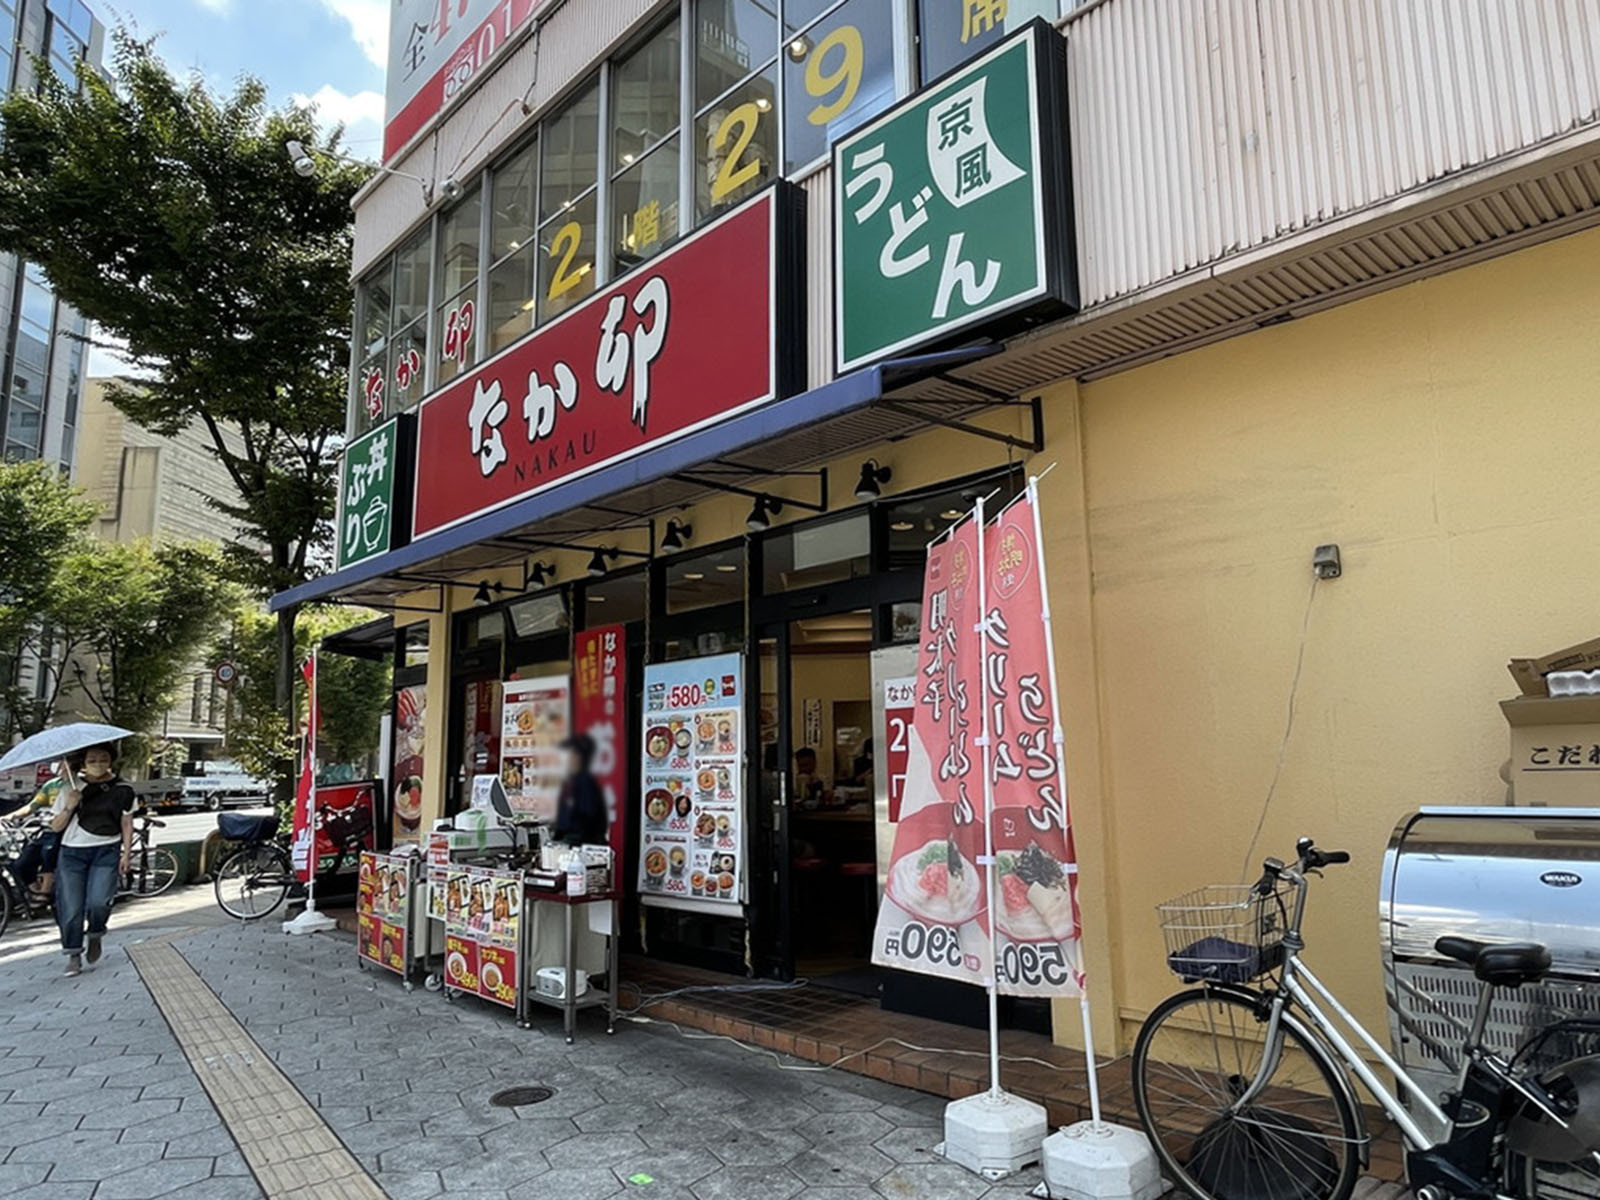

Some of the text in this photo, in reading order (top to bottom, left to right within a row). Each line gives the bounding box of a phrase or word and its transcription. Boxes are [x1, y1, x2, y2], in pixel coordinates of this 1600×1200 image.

[937, 96, 992, 199] 京風
[845, 142, 1001, 319] うどん
[468, 275, 670, 477] なか卯
[513, 431, 597, 484] NAKAU
[671, 684, 700, 708] 580
